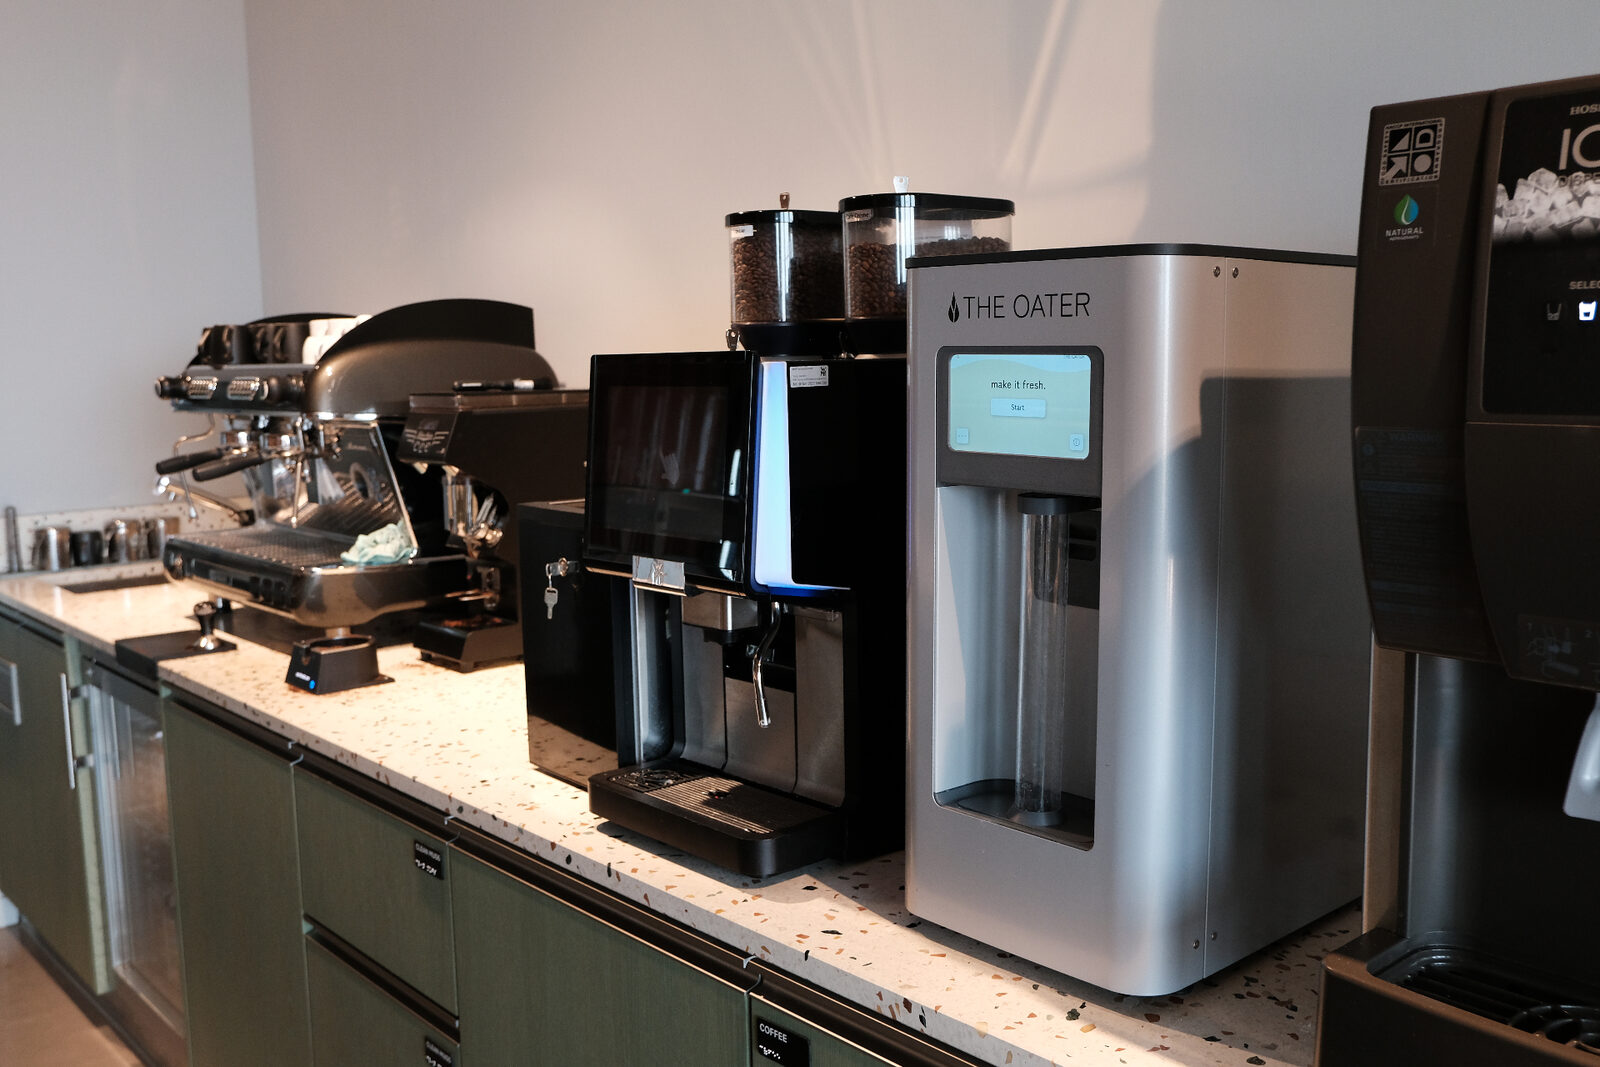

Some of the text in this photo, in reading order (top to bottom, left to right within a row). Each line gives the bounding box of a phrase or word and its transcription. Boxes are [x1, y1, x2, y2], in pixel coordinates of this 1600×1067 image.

[1385, 226, 1424, 237] NATURAL
[963, 292, 1091, 319] THE OATER
[991, 379, 1046, 390] make it fresh.
[1010, 403, 1025, 411] Start
[759, 1023, 788, 1044] COFFEE
